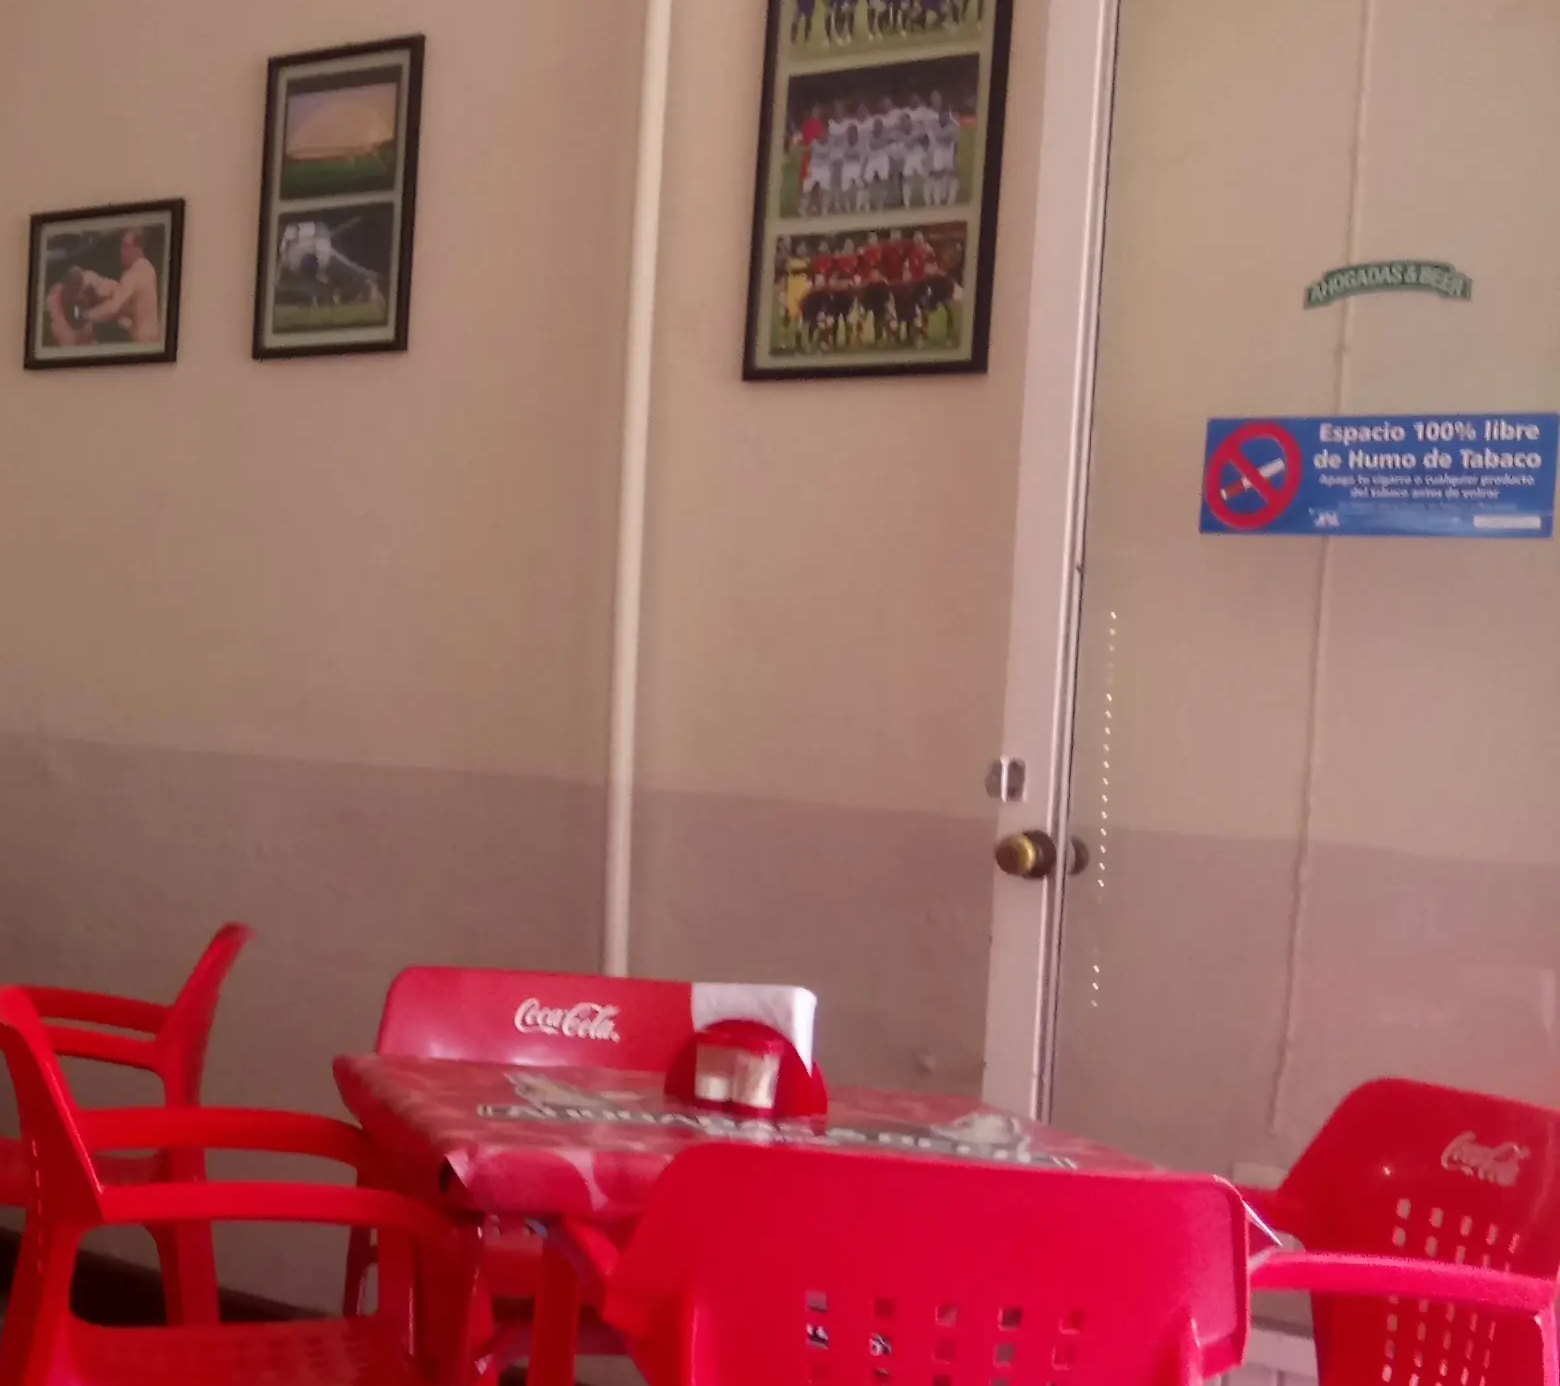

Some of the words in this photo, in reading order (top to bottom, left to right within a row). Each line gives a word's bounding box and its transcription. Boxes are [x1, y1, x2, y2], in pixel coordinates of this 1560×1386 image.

[1319, 421, 1406, 446] Espacio
[1414, 421, 1477, 442] 100%
[1484, 419, 1540, 442] libre
[1313, 449, 1342, 469] de
[1348, 450, 1417, 469] Humo
[1423, 447, 1453, 469] de
[1459, 447, 1542, 469] Tabaco
